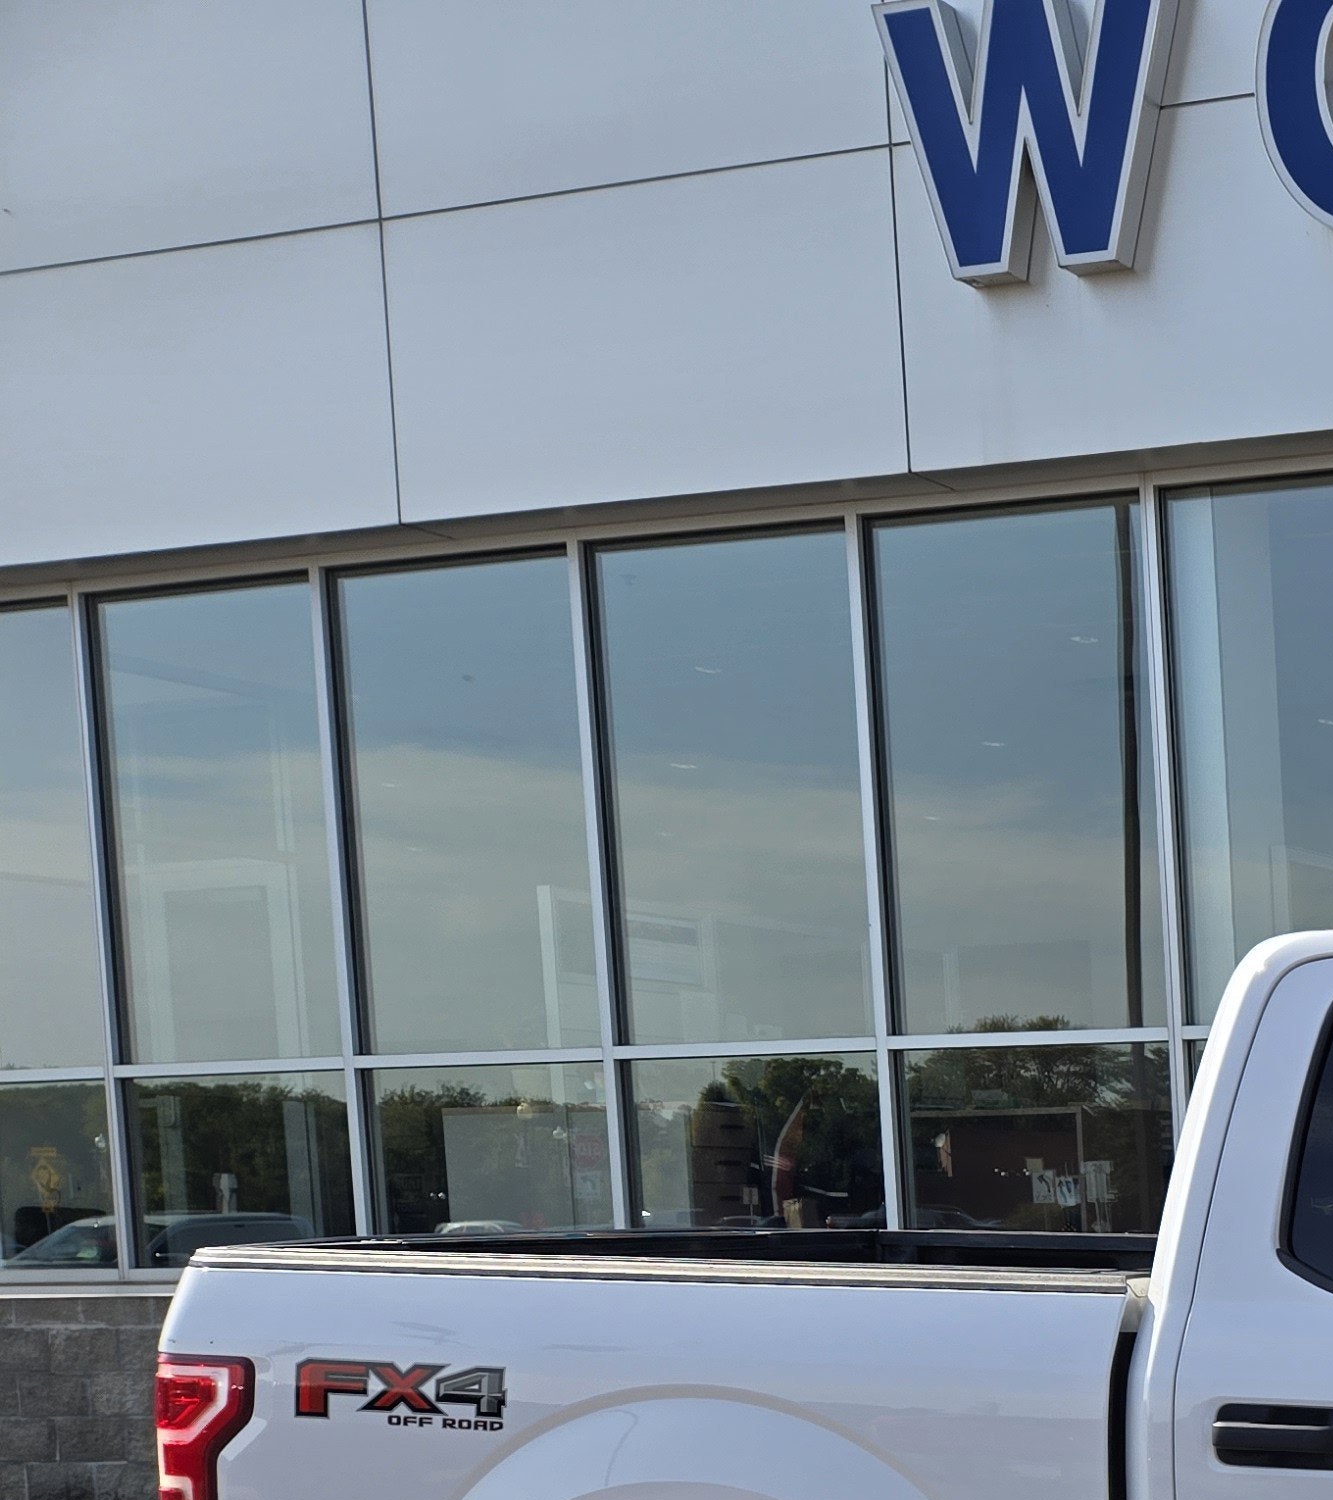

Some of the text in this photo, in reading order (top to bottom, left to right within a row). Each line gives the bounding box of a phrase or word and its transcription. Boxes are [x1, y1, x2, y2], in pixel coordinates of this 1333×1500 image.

[294, 1357, 508, 1419] FX4
[387, 1415, 504, 1431] OFF ROAD
